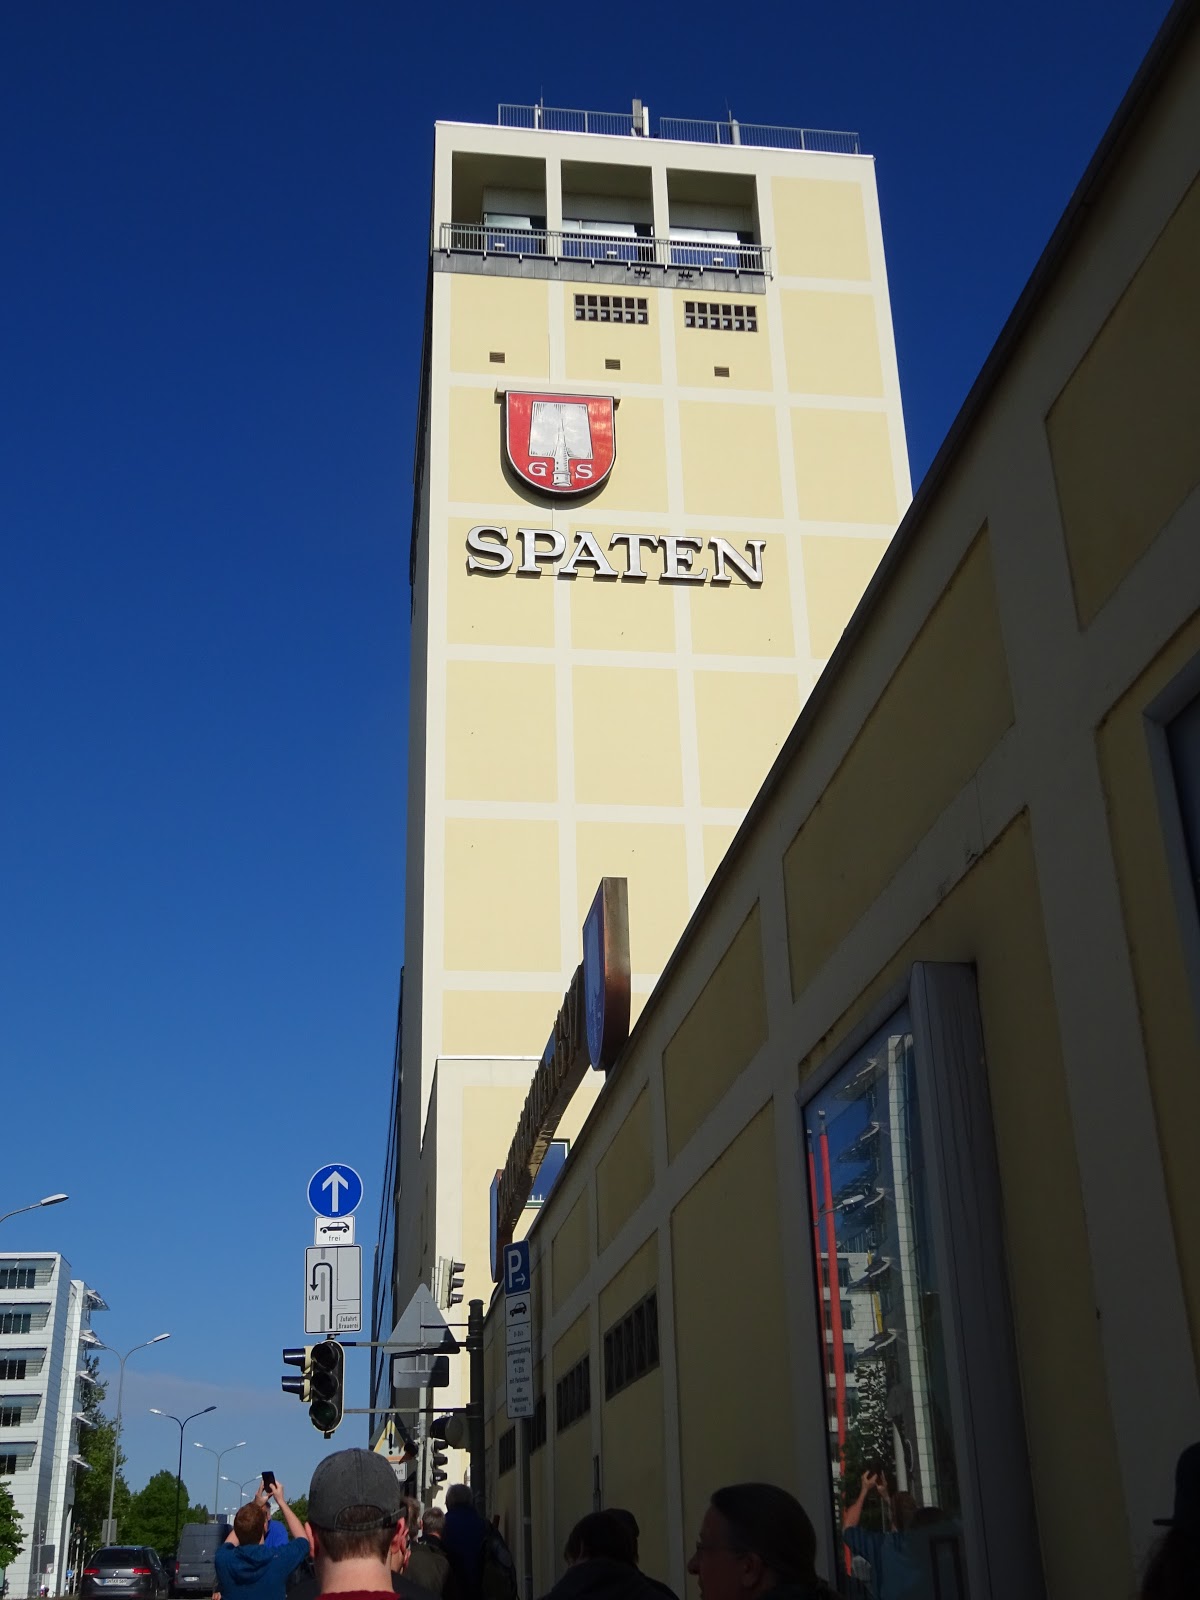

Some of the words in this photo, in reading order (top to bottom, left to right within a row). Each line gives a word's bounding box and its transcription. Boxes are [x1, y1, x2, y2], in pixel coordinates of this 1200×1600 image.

[528, 462, 548, 477] G
[575, 463, 594, 479] S
[466, 525, 767, 588] SPATEN
[508, 1249, 523, 1289] P
